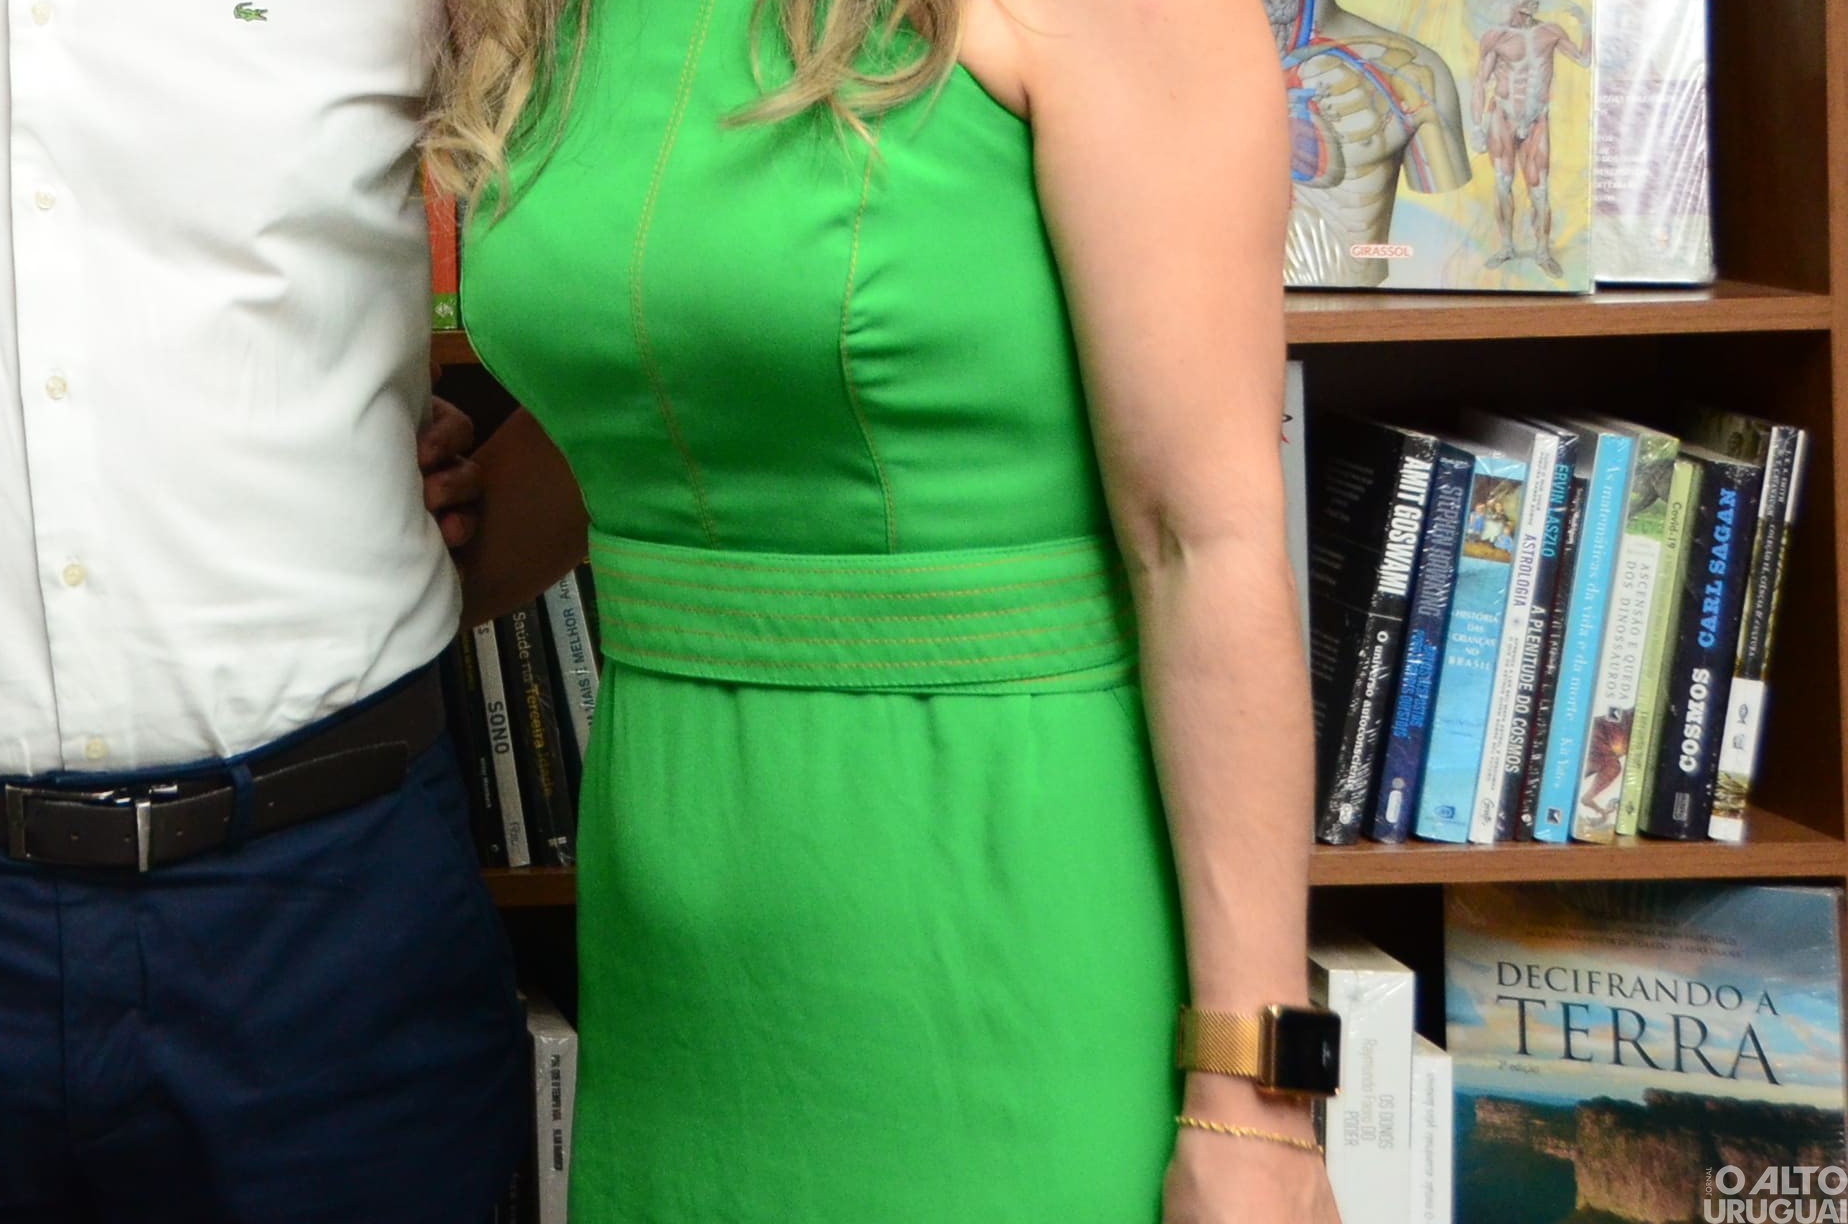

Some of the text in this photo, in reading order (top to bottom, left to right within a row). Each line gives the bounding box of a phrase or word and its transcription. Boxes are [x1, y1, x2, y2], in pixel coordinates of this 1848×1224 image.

[1352, 246, 1410, 257] GIRASSOL
[1393, 455, 1432, 506] AMIT
[1429, 483, 1464, 545] STEPHEN
[1373, 503, 1422, 597] GOSWAMI
[1664, 500, 1682, 550] Covid-19
[1512, 532, 1538, 608] ASTROLOGIA
[1697, 487, 1737, 649] CARL SAGAN
[568, 607, 585, 663] MELHOR
[1374, 629, 1389, 643] O
[1603, 559, 1636, 700] DOS DINOSSAUROS
[1616, 561, 1652, 702] ASCENSÃO E QUEDA
[513, 611, 547, 750] Saúde Terceira
[1503, 617, 1544, 773] PLENITUDE DO COSMOS
[487, 700, 510, 755] SONO
[1677, 667, 1710, 774] COSMOS
[1496, 961, 1779, 1016] DECIFRANDO A
[1496, 995, 1783, 1087] TERRA
